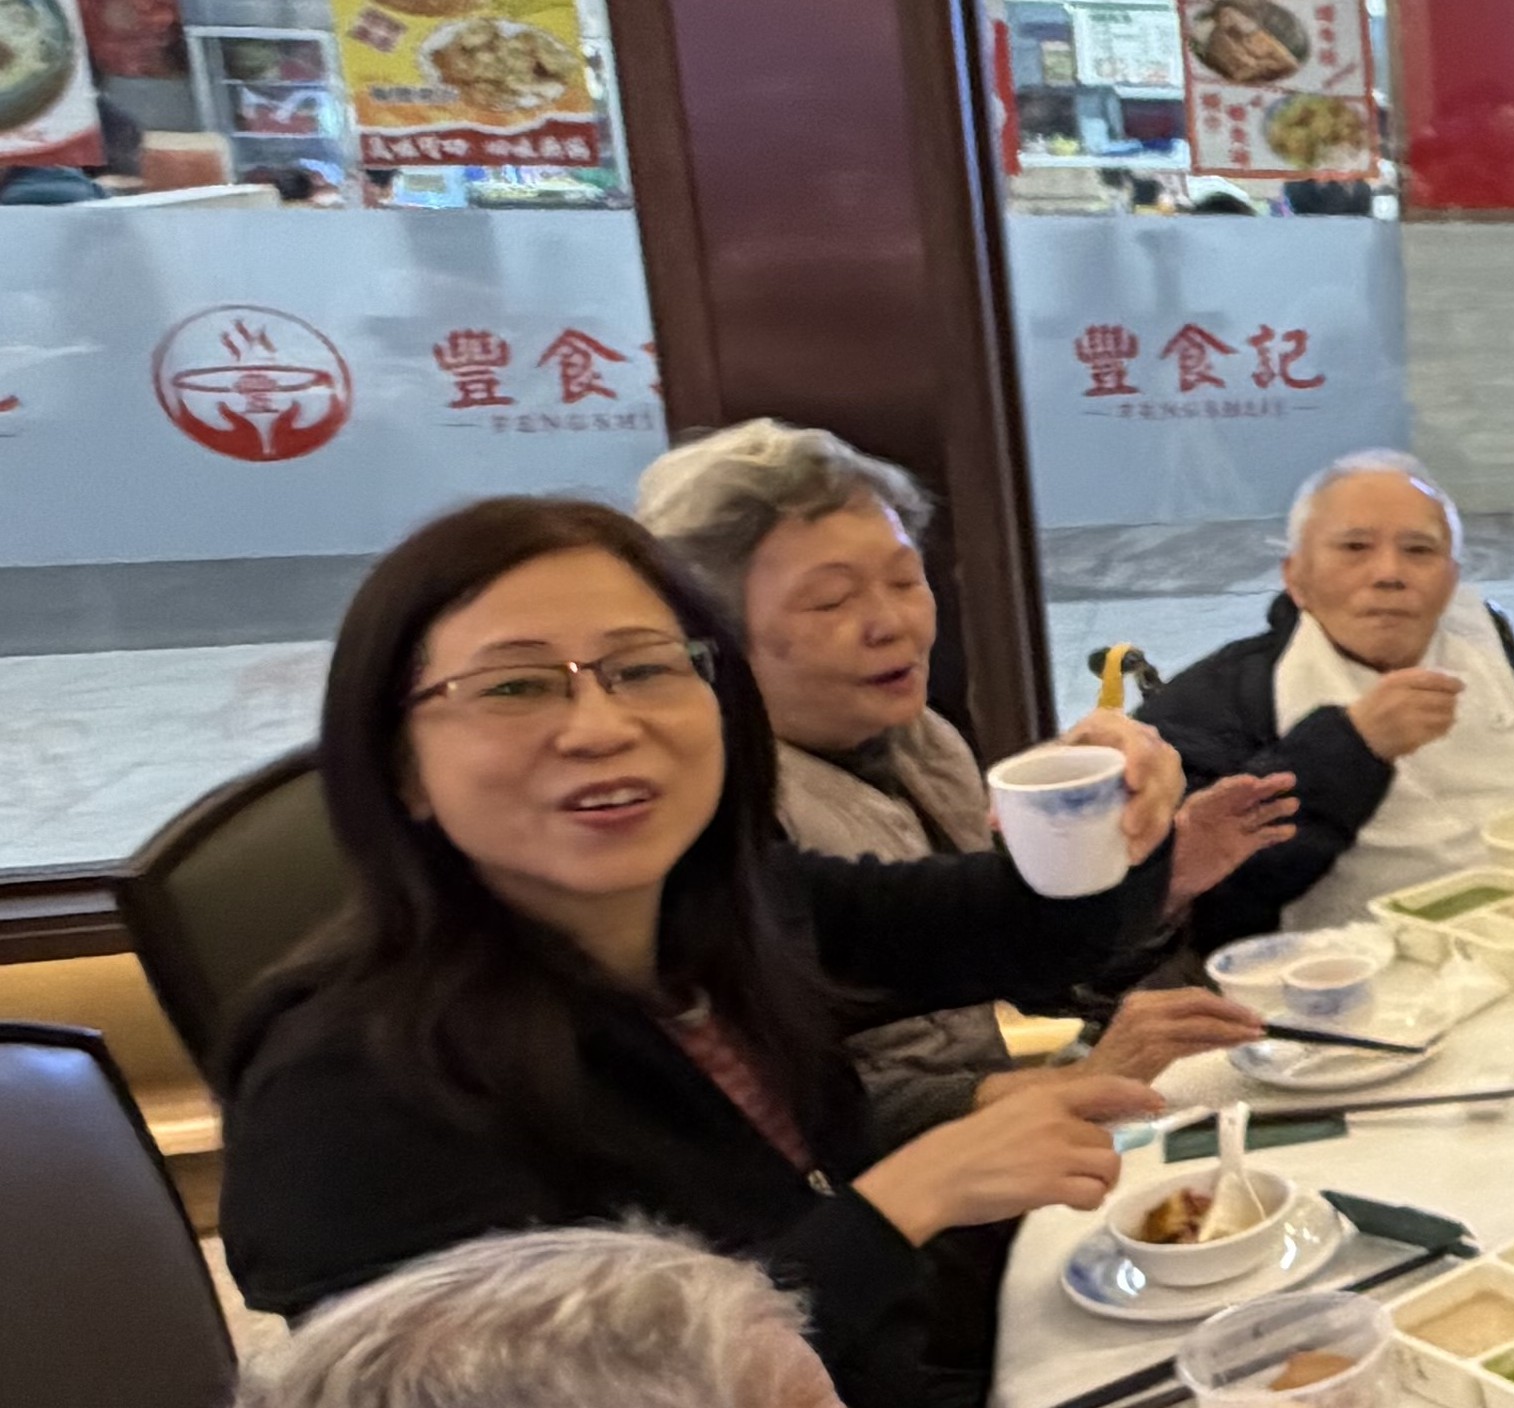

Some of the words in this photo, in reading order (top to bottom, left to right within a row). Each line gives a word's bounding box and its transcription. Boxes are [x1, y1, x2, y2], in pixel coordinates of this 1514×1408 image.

[433, 329, 659, 407] 豐食
[1074, 324, 1326, 396] 豐食記
